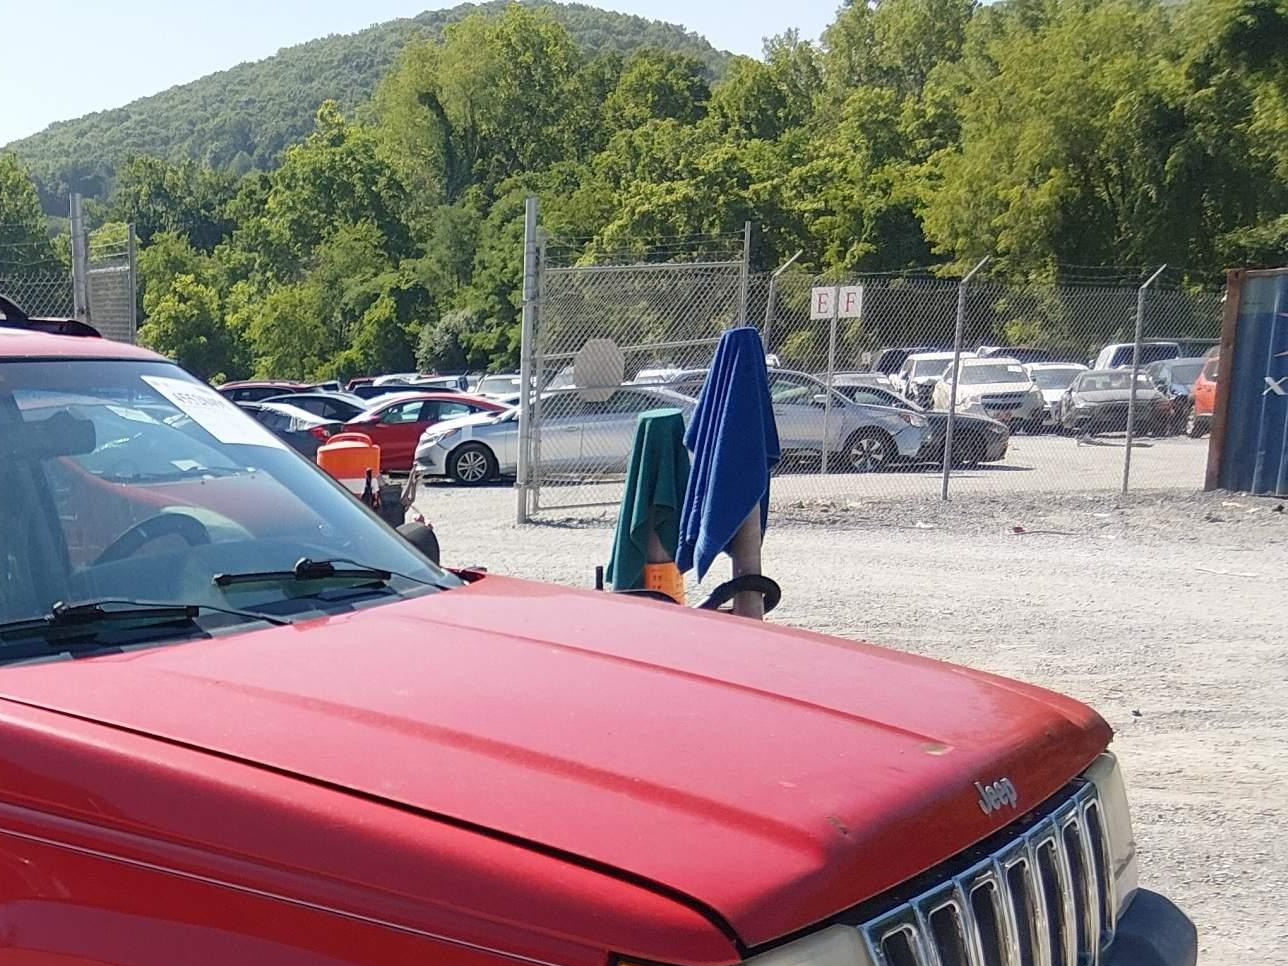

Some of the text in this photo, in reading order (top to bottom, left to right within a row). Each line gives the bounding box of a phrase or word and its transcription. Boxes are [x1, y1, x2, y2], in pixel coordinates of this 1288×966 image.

[817, 292, 829, 313] E
[844, 292, 856, 312] F
[974, 777, 1017, 816] Jeep
